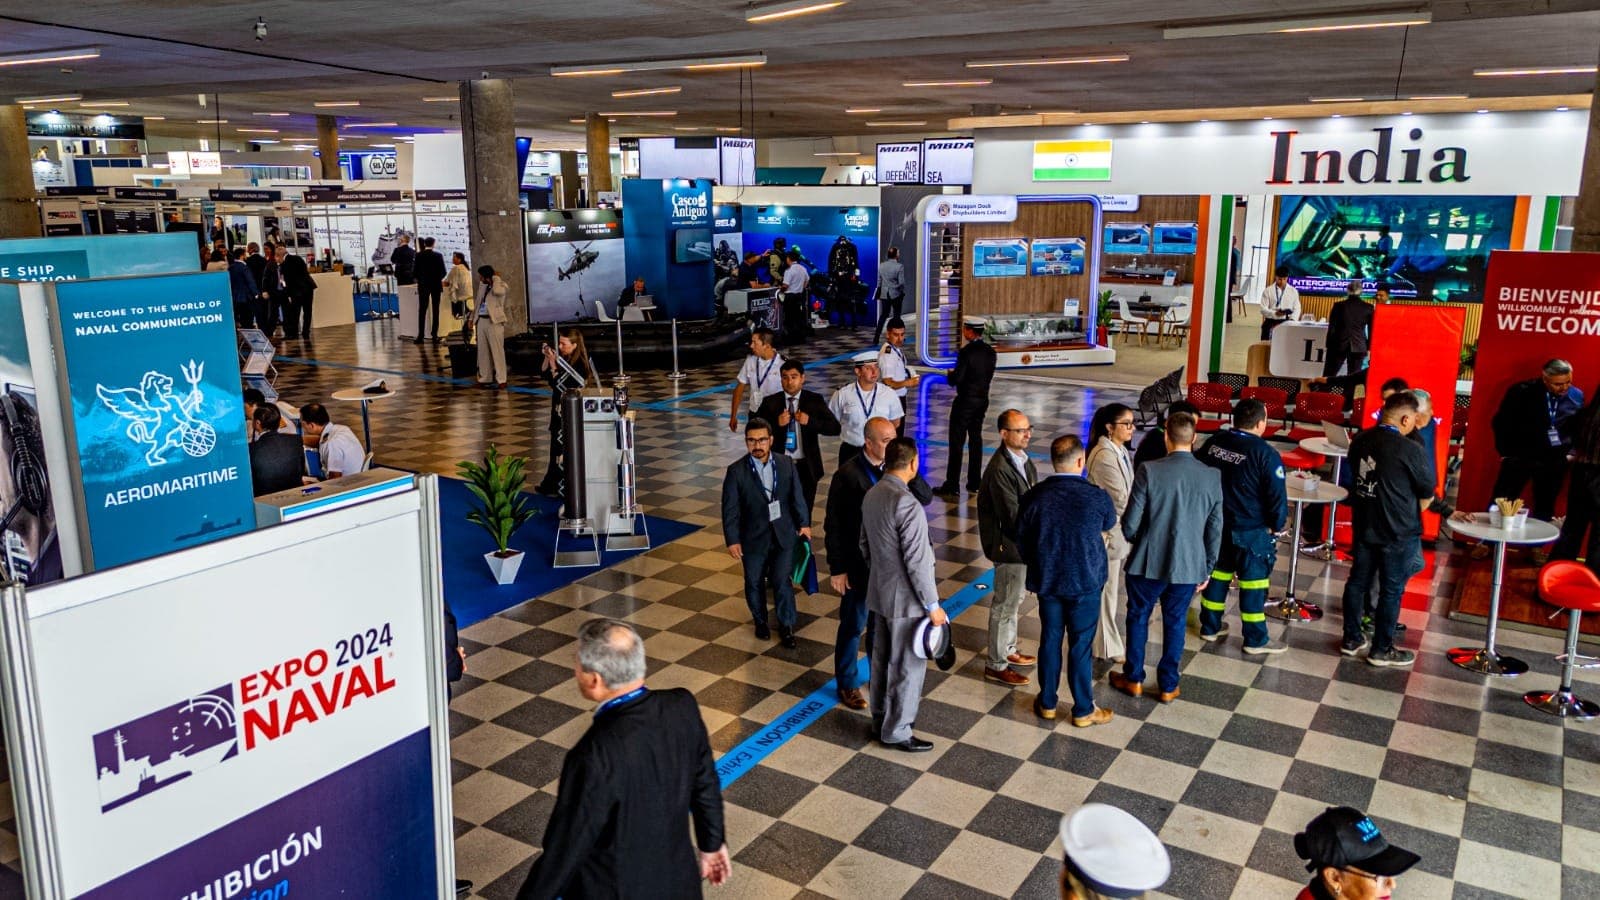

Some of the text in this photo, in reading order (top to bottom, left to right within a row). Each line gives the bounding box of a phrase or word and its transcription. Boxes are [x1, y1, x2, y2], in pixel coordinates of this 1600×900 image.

[723, 140, 753, 148] MBDA
[928, 142, 974, 150] MBDA
[1265, 127, 1471, 184] India
[905, 160, 917, 171] AIR
[886, 170, 917, 181] DEFENCE
[927, 171, 943, 183] SEA
[672, 193, 698, 206] Casco
[672, 205, 707, 220] Antiguo
[17, 264, 55, 277] SHIP
[73, 300, 221, 320] WELCOME TO THE WORLD OF
[1497, 303, 1566, 314] WILLKOMMEN
[75, 313, 223, 337] NAVAL COMMUNICATION
[104, 466, 239, 508] AEROMARITIME
[240, 622, 393, 704] EXPO 2024
[242, 655, 396, 751] NAVAL
[756, 701, 824, 747] EXHIBICIÓN
